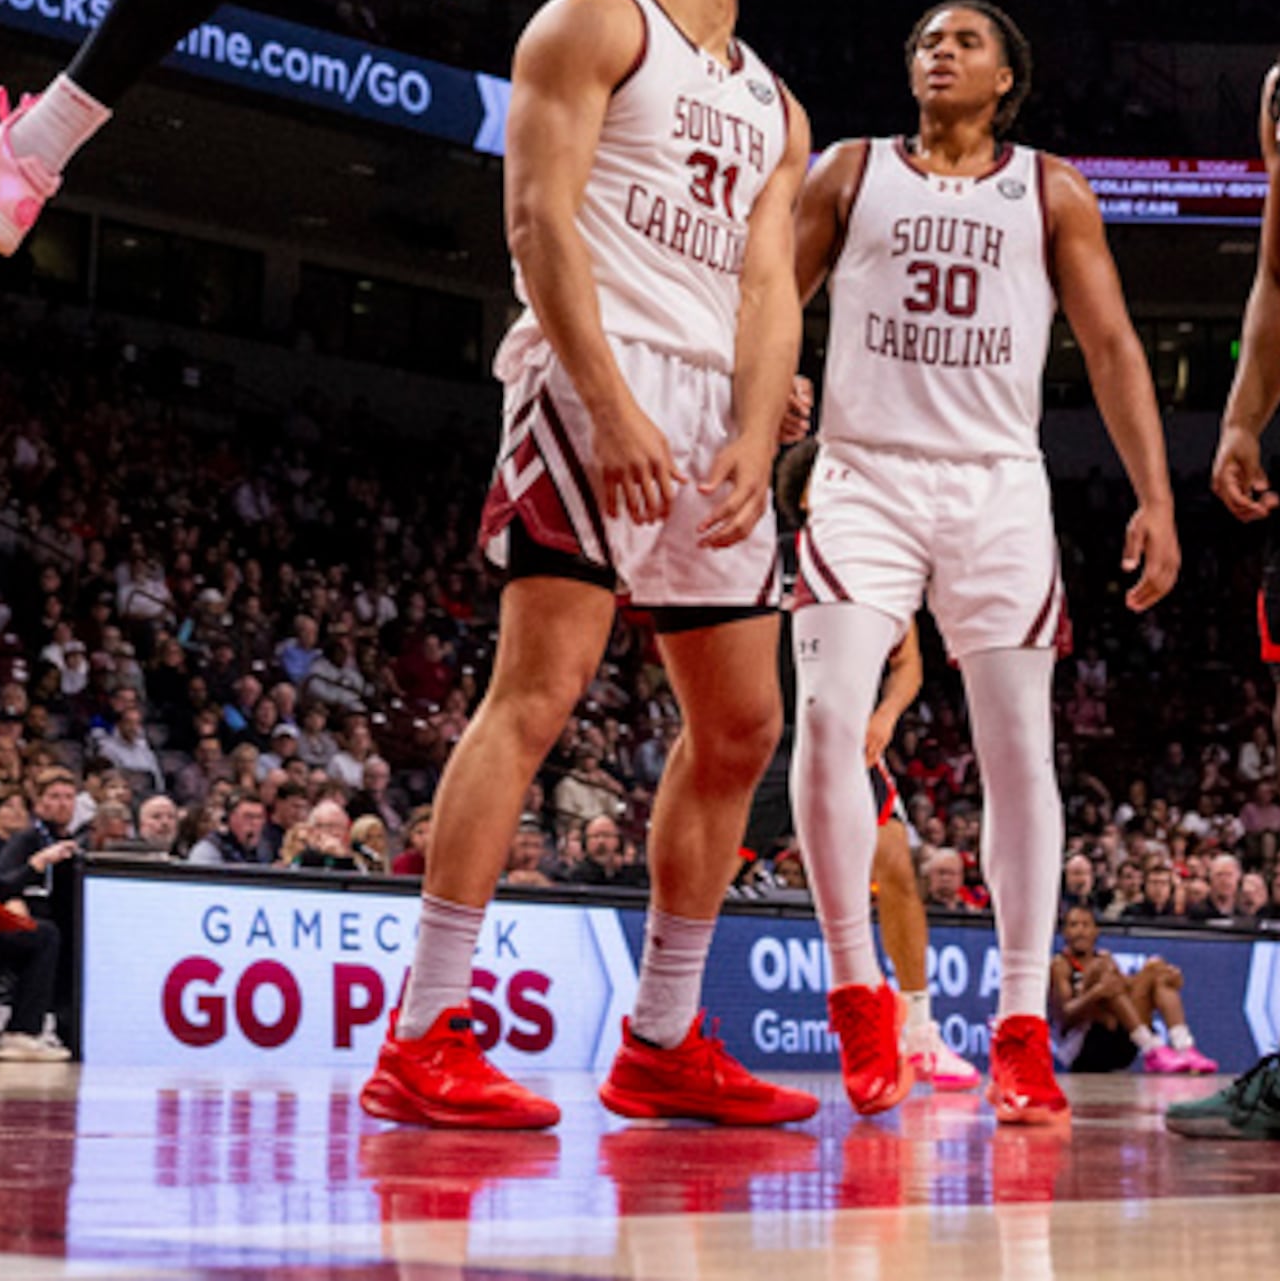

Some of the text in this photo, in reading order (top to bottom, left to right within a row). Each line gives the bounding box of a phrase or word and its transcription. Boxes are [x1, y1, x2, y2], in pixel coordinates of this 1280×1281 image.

[672, 94, 765, 173] SOUTH
[685, 149, 740, 220] 31
[891, 214, 1005, 270] SOUTH
[903, 259, 980, 319] 30
[865, 310, 1012, 369] CAROLINA
[201, 904, 520, 959] GAMECK
[160, 955, 557, 1054] GO PSS
